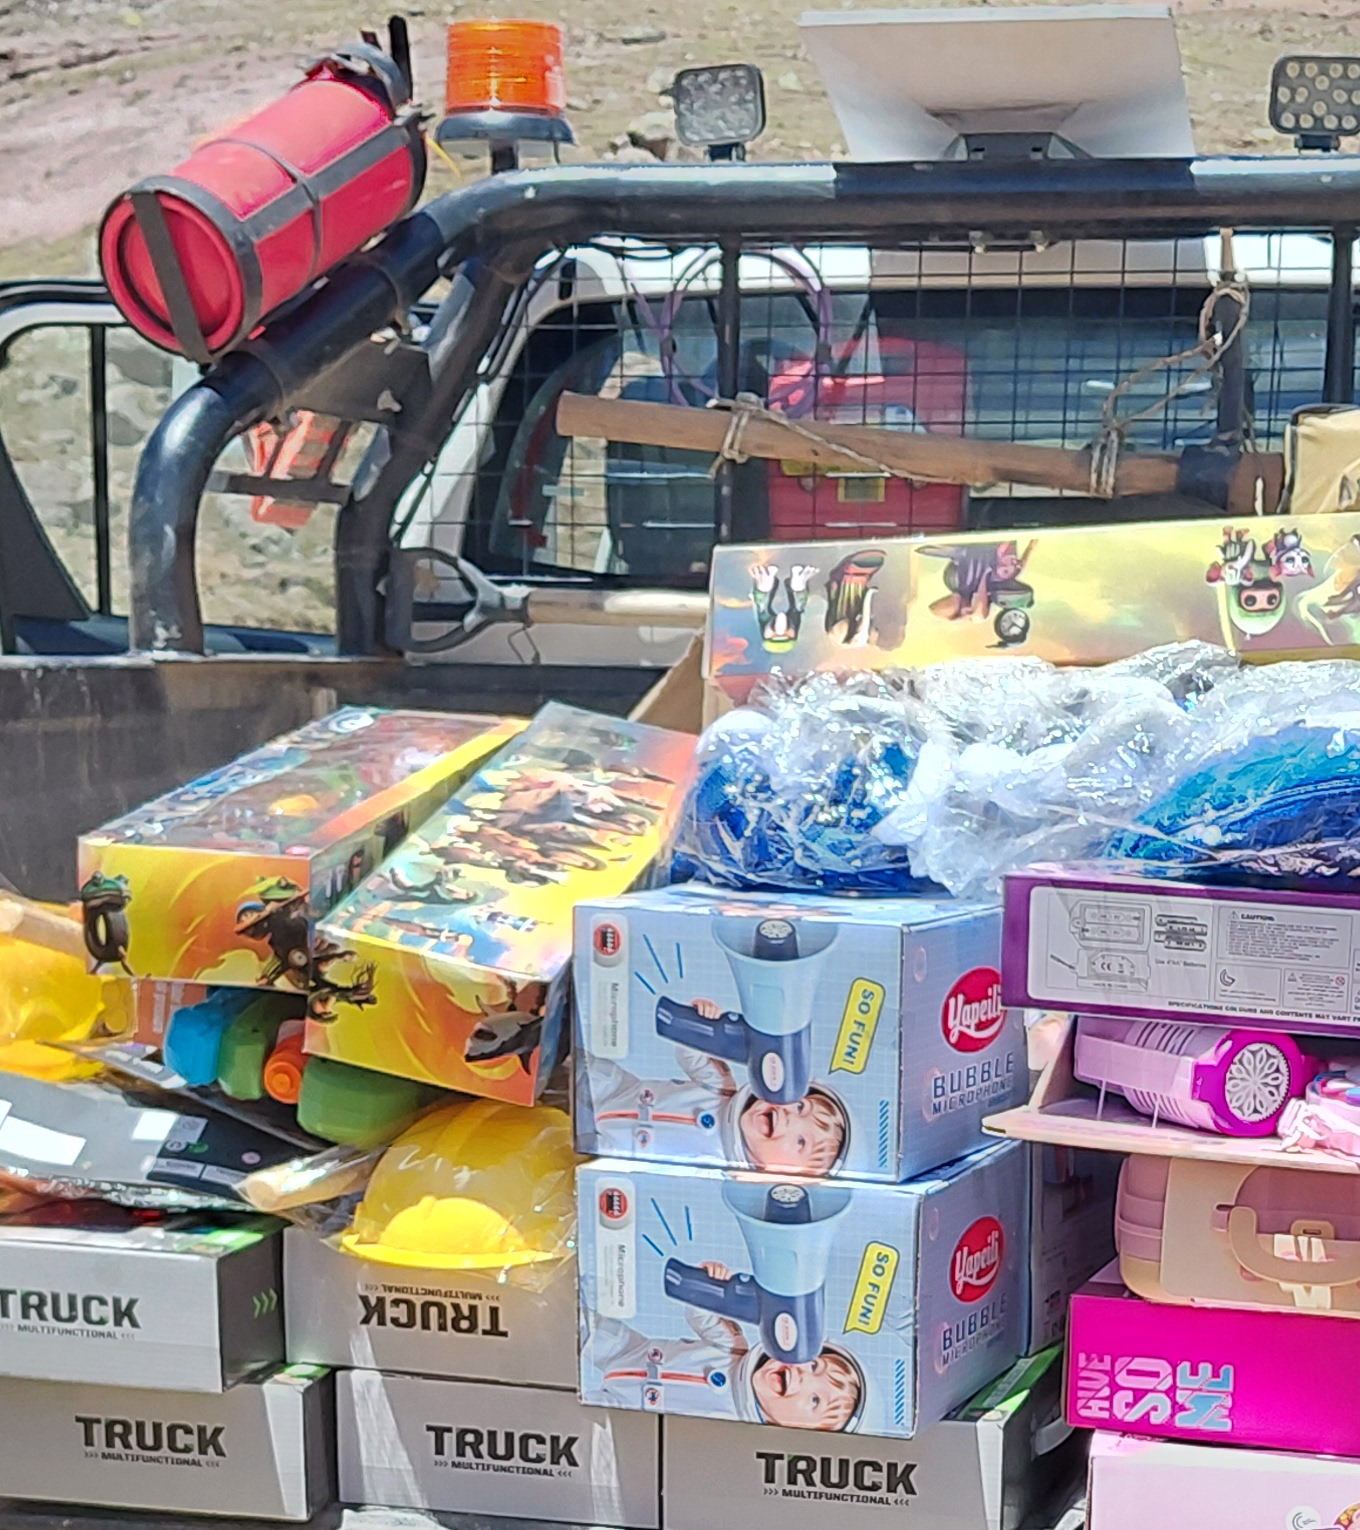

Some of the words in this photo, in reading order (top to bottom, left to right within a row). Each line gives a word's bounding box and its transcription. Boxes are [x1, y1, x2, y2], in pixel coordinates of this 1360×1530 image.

[858, 988, 875, 1015] SO
[843, 1019, 866, 1066] FUN!
[932, 1075, 1014, 1115] MICROPHONE
[933, 1052, 1014, 1099] BUBBLE
[617, 1244, 626, 1307] Microphone
[872, 1251, 890, 1277] SO
[955, 1230, 999, 1295] Yapeili
[381, 1283, 483, 1301] MULTIFUNCTIONAL
[858, 1281, 880, 1326] FUN!
[17, 1323, 118, 1340] MULTIFUNCTIONAL
[358, 1294, 509, 1338] TRUCK
[943, 1293, 1006, 1351] BUBBLE
[1113, 1356, 1171, 1425] SO
[1176, 1361, 1234, 1432] ME
[74, 1415, 227, 1458] TRUCK
[425, 1424, 579, 1467] TRUCK
[101, 1451, 203, 1468] MULTIFUNCTIONAL
[451, 1460, 555, 1477] MULTIFUNCTIONAL
[756, 1451, 918, 1496] TRUCK
[782, 1488, 892, 1506] MULTIFUNCTIONAL
